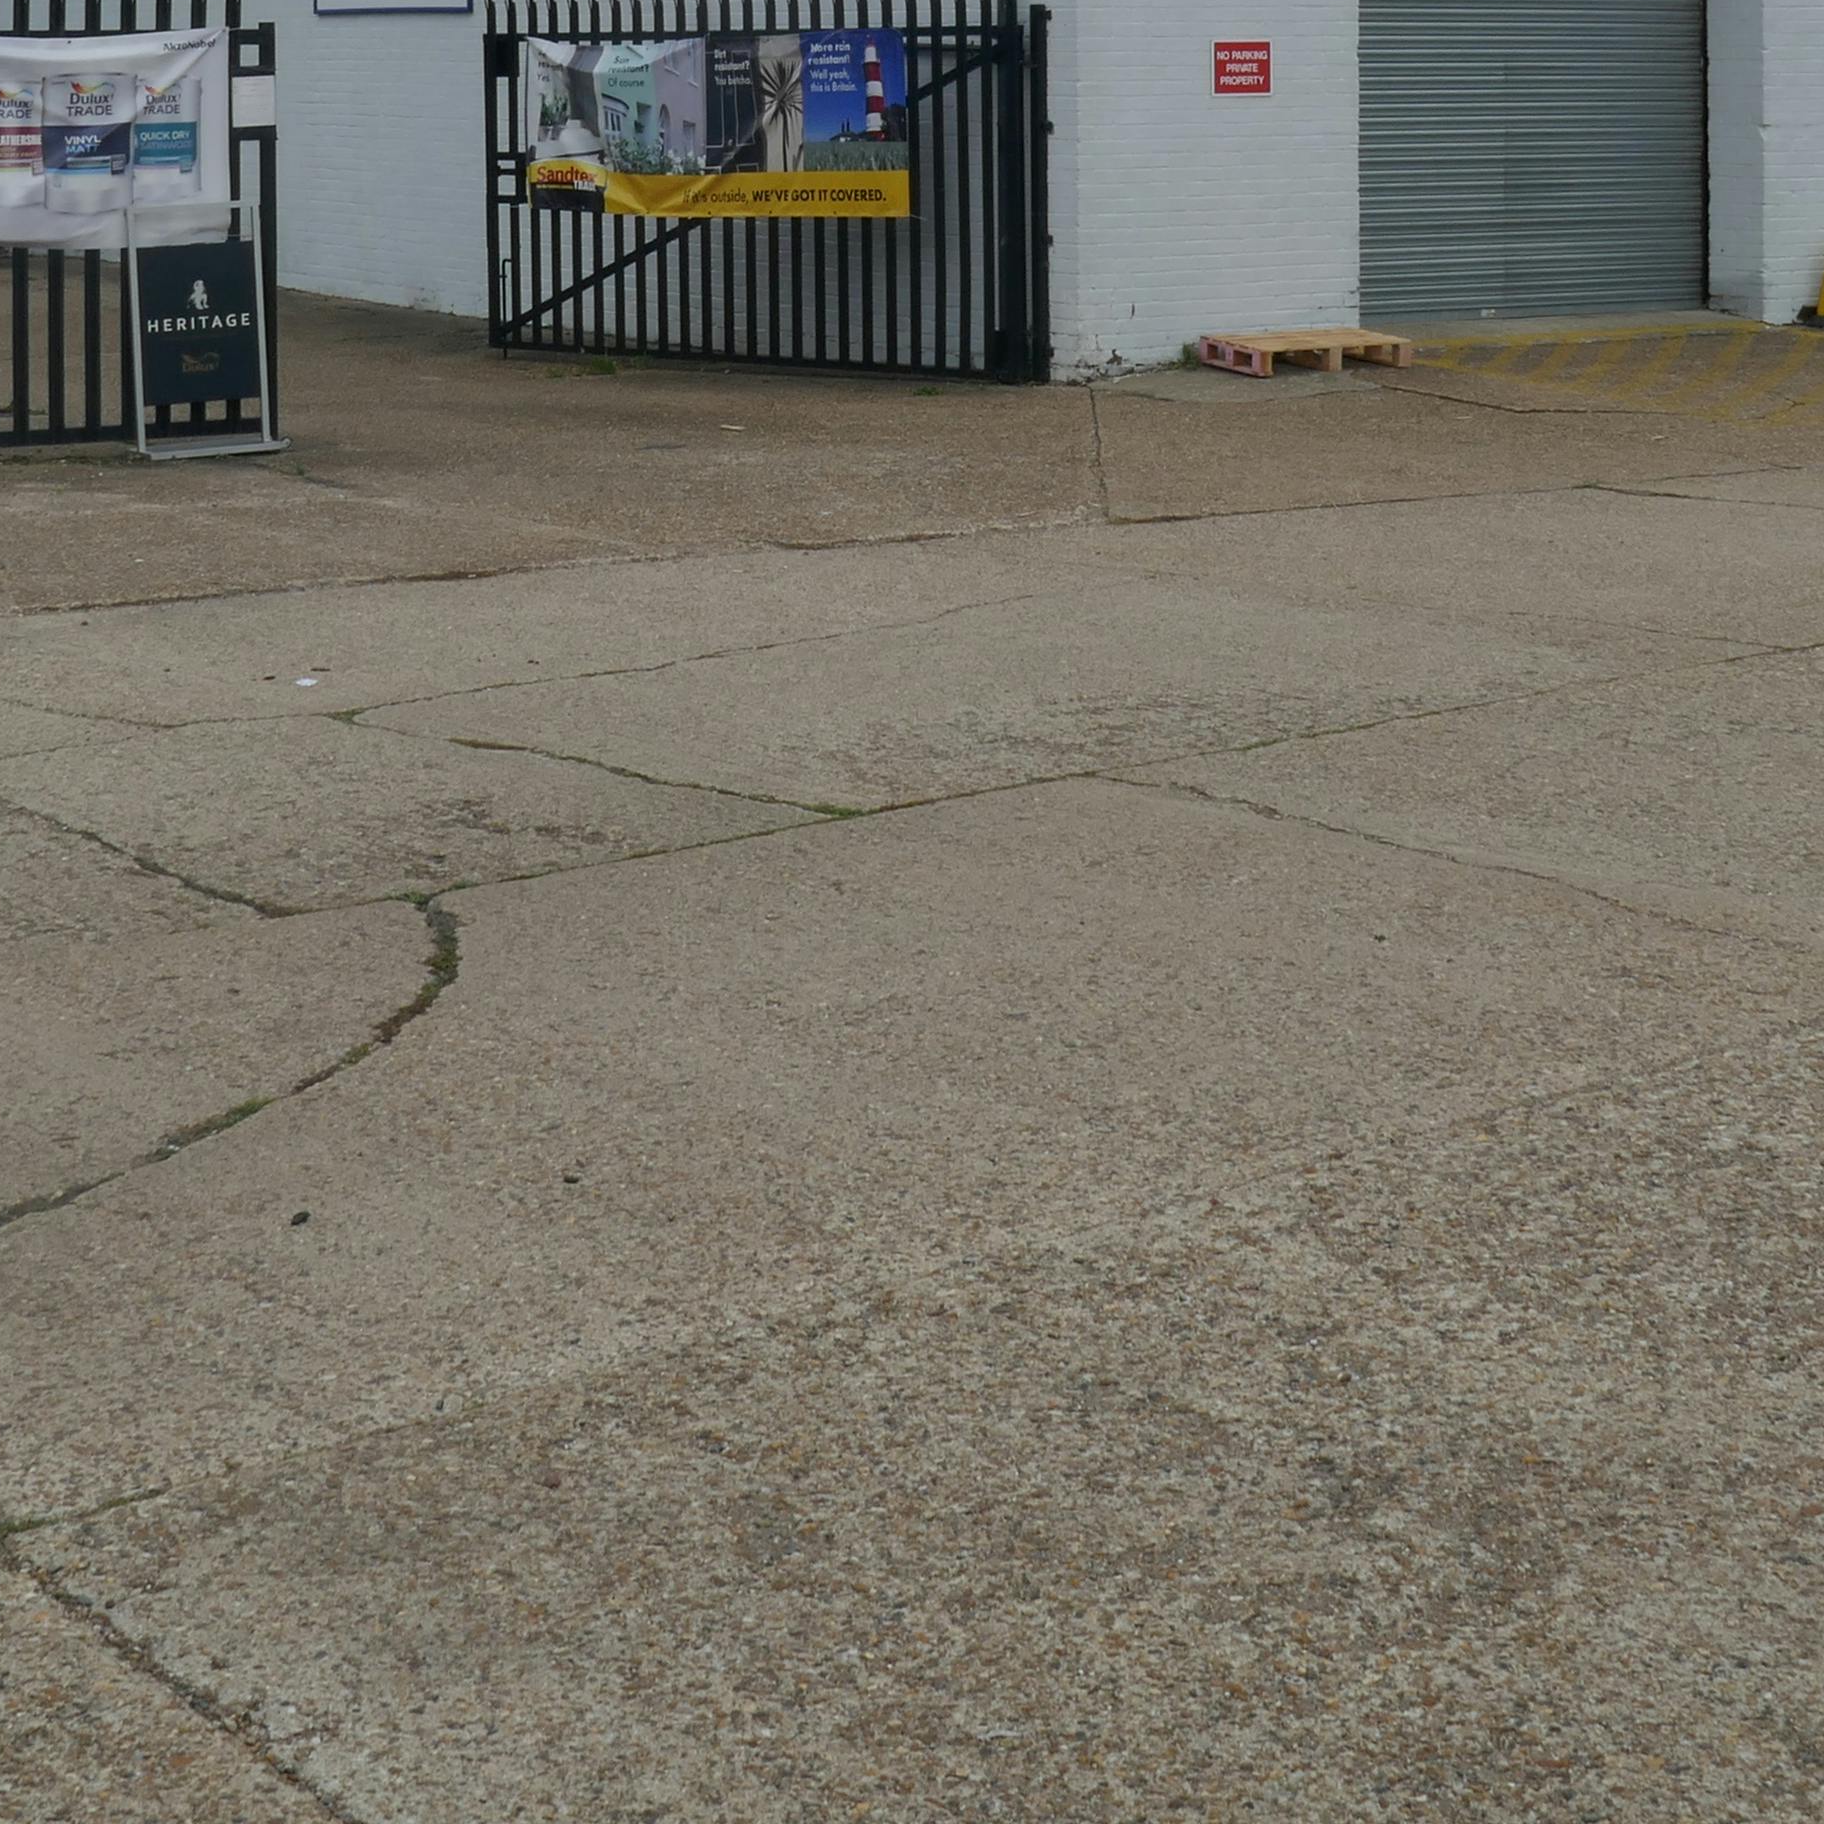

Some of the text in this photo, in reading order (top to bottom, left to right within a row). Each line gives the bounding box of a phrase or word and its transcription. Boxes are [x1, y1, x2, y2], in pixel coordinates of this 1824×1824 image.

[810, 42, 851, 53] More rain
[1216, 50, 1268, 60] NO PARKING
[1226, 63, 1259, 73] PRIVATE
[810, 69, 827, 79] Well
[607, 78, 645, 88] Of course
[1219, 76, 1264, 85] PROPERTY
[810, 82, 824, 92] this
[825, 82, 831, 92] is
[70, 93, 109, 105] Dulux
[66, 105, 113, 117] TRADE
[143, 104, 181, 115] TRADE
[65, 135, 101, 144] VINYL
[140, 130, 190, 141] QUICK DRY
[65, 144, 97, 153] MATT
[711, 188, 749, 205] outside,
[752, 189, 789, 202] WE'VE
[790, 189, 816, 202] GOT
[818, 189, 828, 202] IT
[830, 188, 887, 202] COVERED.
[147, 313, 251, 333] HERITAGE
